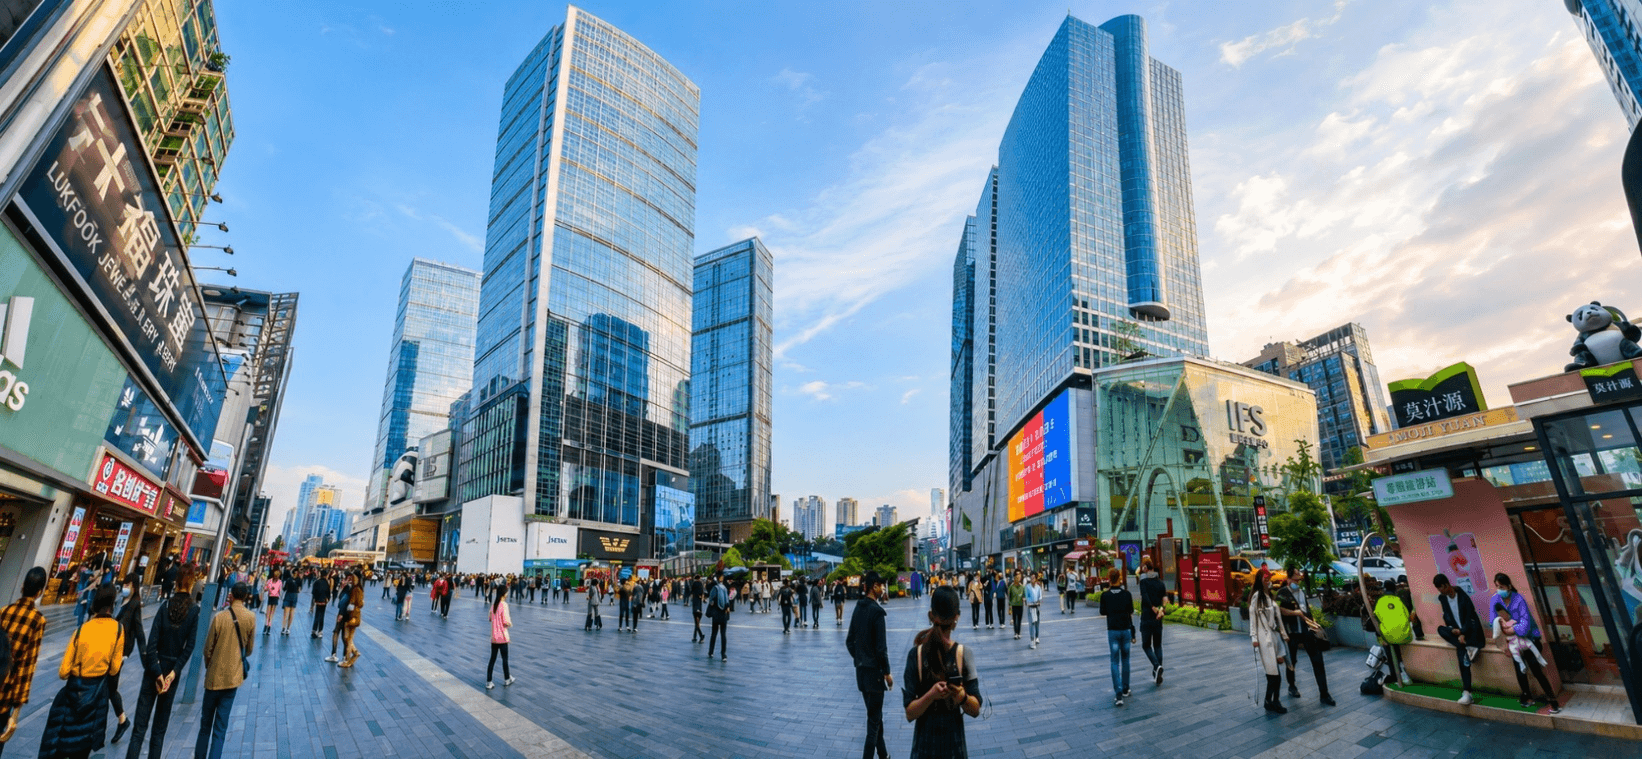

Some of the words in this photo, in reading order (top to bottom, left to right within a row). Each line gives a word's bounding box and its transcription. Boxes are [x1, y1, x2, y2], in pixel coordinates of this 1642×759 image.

[47, 160, 103, 254] LUKFOOK
[1226, 399, 1268, 437] IFS
[1439, 415, 1487, 433] YUAN
